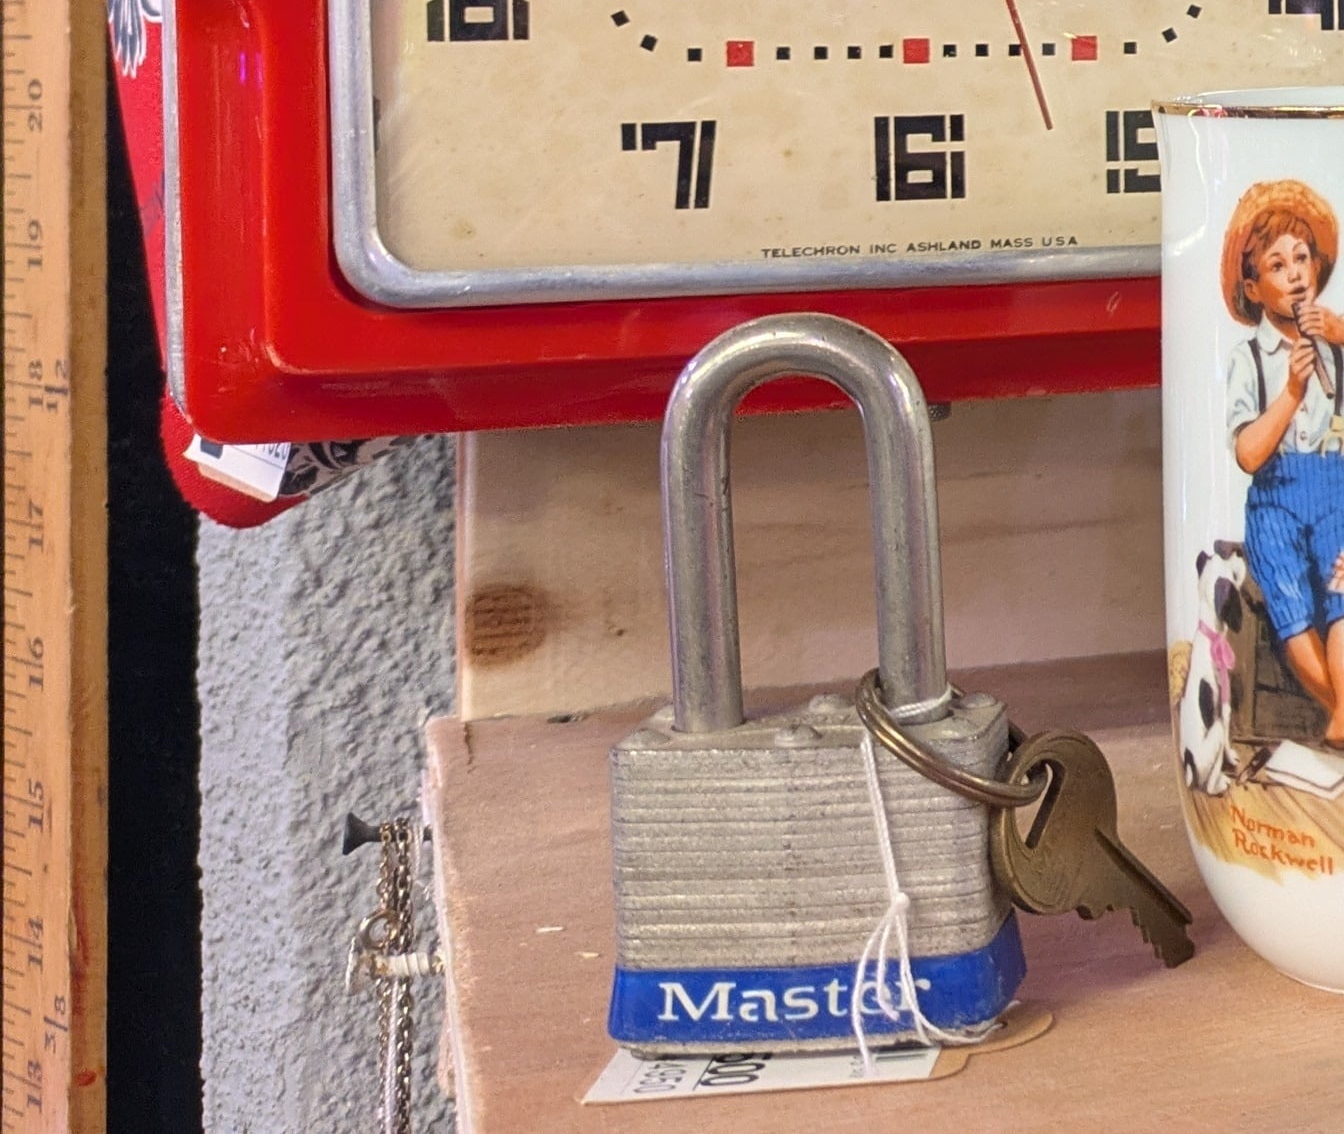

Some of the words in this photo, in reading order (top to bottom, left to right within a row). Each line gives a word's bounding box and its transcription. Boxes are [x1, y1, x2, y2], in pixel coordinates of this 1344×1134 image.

[27, 78, 43, 133] 20
[620, 120, 717, 209] 7
[874, 114, 966, 202] 6
[27, 219, 43, 271] 19
[761, 245, 860, 259] TELECHRON
[869, 243, 897, 254] INC
[906, 239, 982, 252] ASHLAND
[990, 237, 1034, 249] MASS
[27, 359, 44, 411] 18
[28, 499, 44, 553] 17
[28, 636, 44, 692] 16
[28, 780, 44, 833] 15
[1230, 805, 1316, 848] Norman
[1232, 828, 1334, 876] Rockwell
[28, 917, 44, 972] 14
[657, 978, 931, 1021] Master
[27, 1059, 43, 1114] 13
